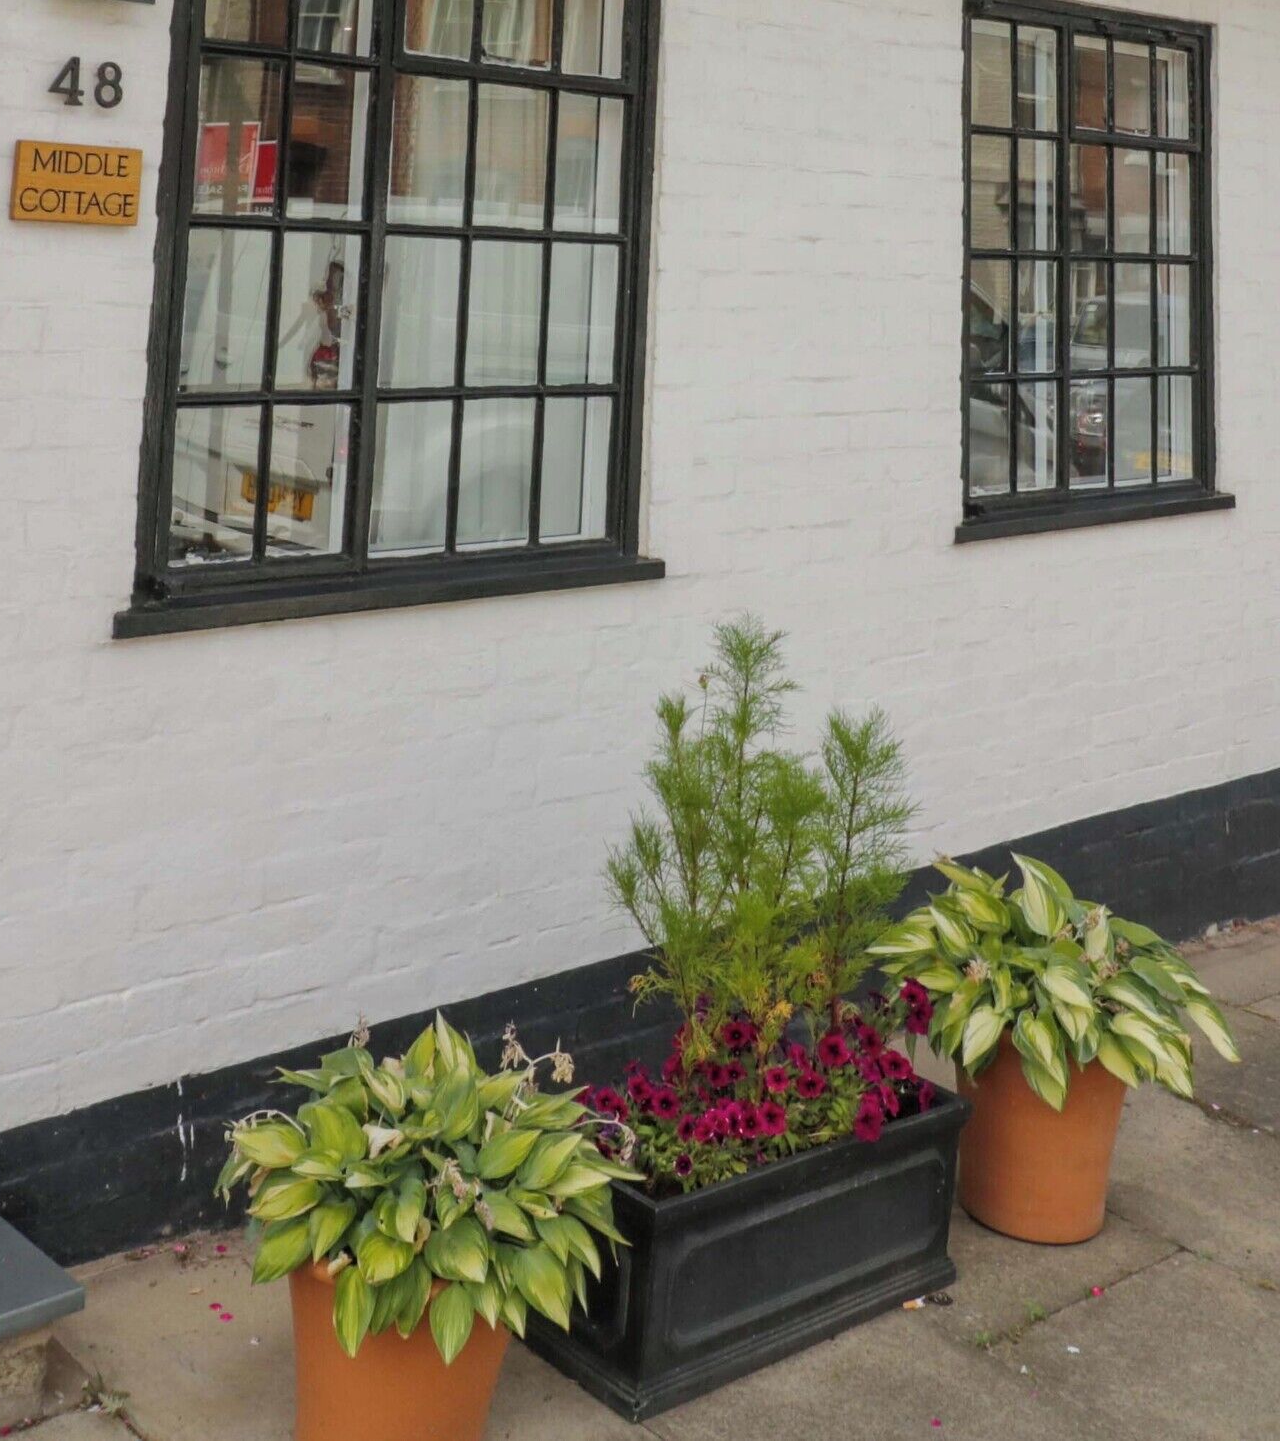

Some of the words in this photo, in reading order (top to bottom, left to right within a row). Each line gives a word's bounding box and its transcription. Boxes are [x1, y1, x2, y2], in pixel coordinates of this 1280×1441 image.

[48, 56, 123, 108] 48
[31, 148, 129, 178] MIDDLE
[20, 187, 135, 218] COTTAGE
